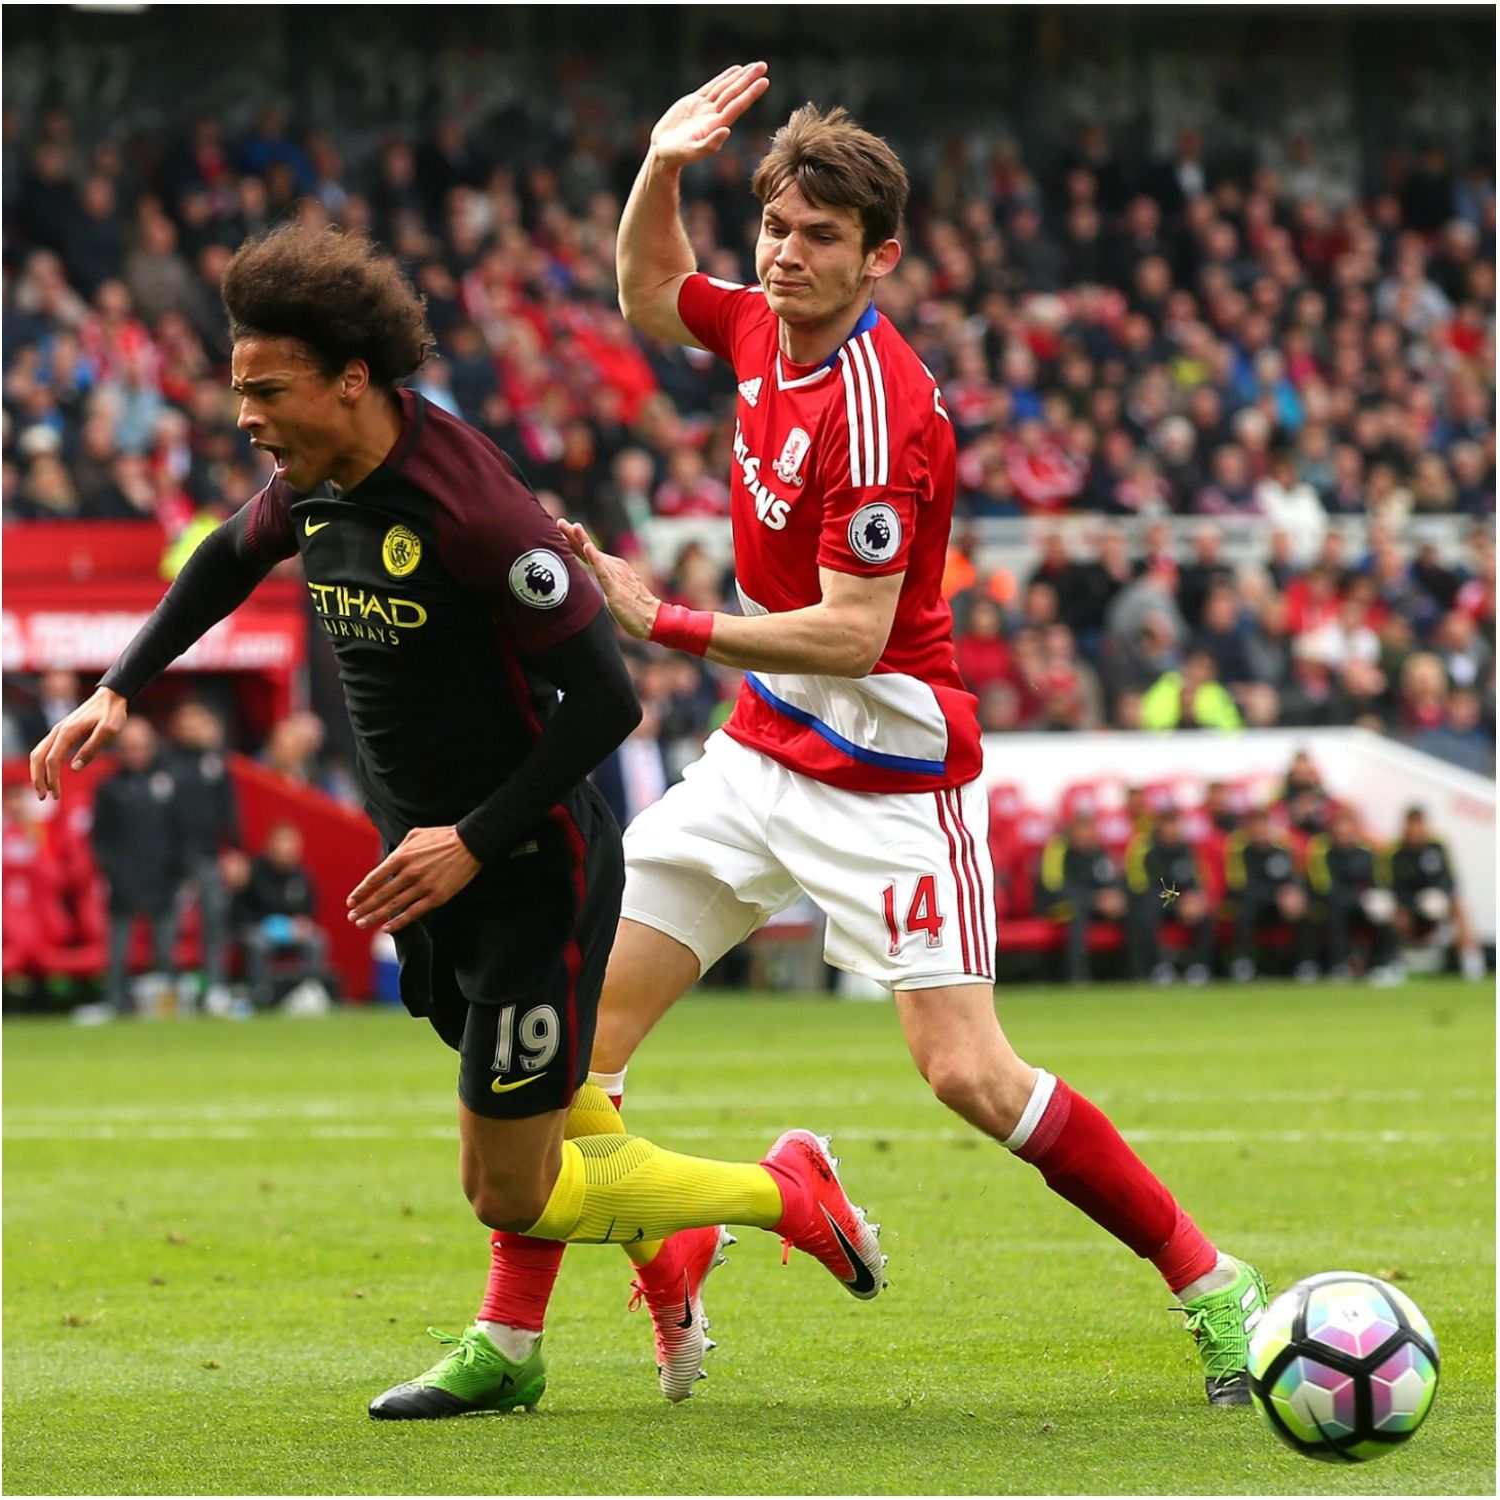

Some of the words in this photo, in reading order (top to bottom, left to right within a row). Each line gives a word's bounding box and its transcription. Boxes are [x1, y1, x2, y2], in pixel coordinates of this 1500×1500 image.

[323, 619, 400, 646] AIRWAYS
[880, 873, 947, 957] 14
[490, 1003, 561, 1074] 19
